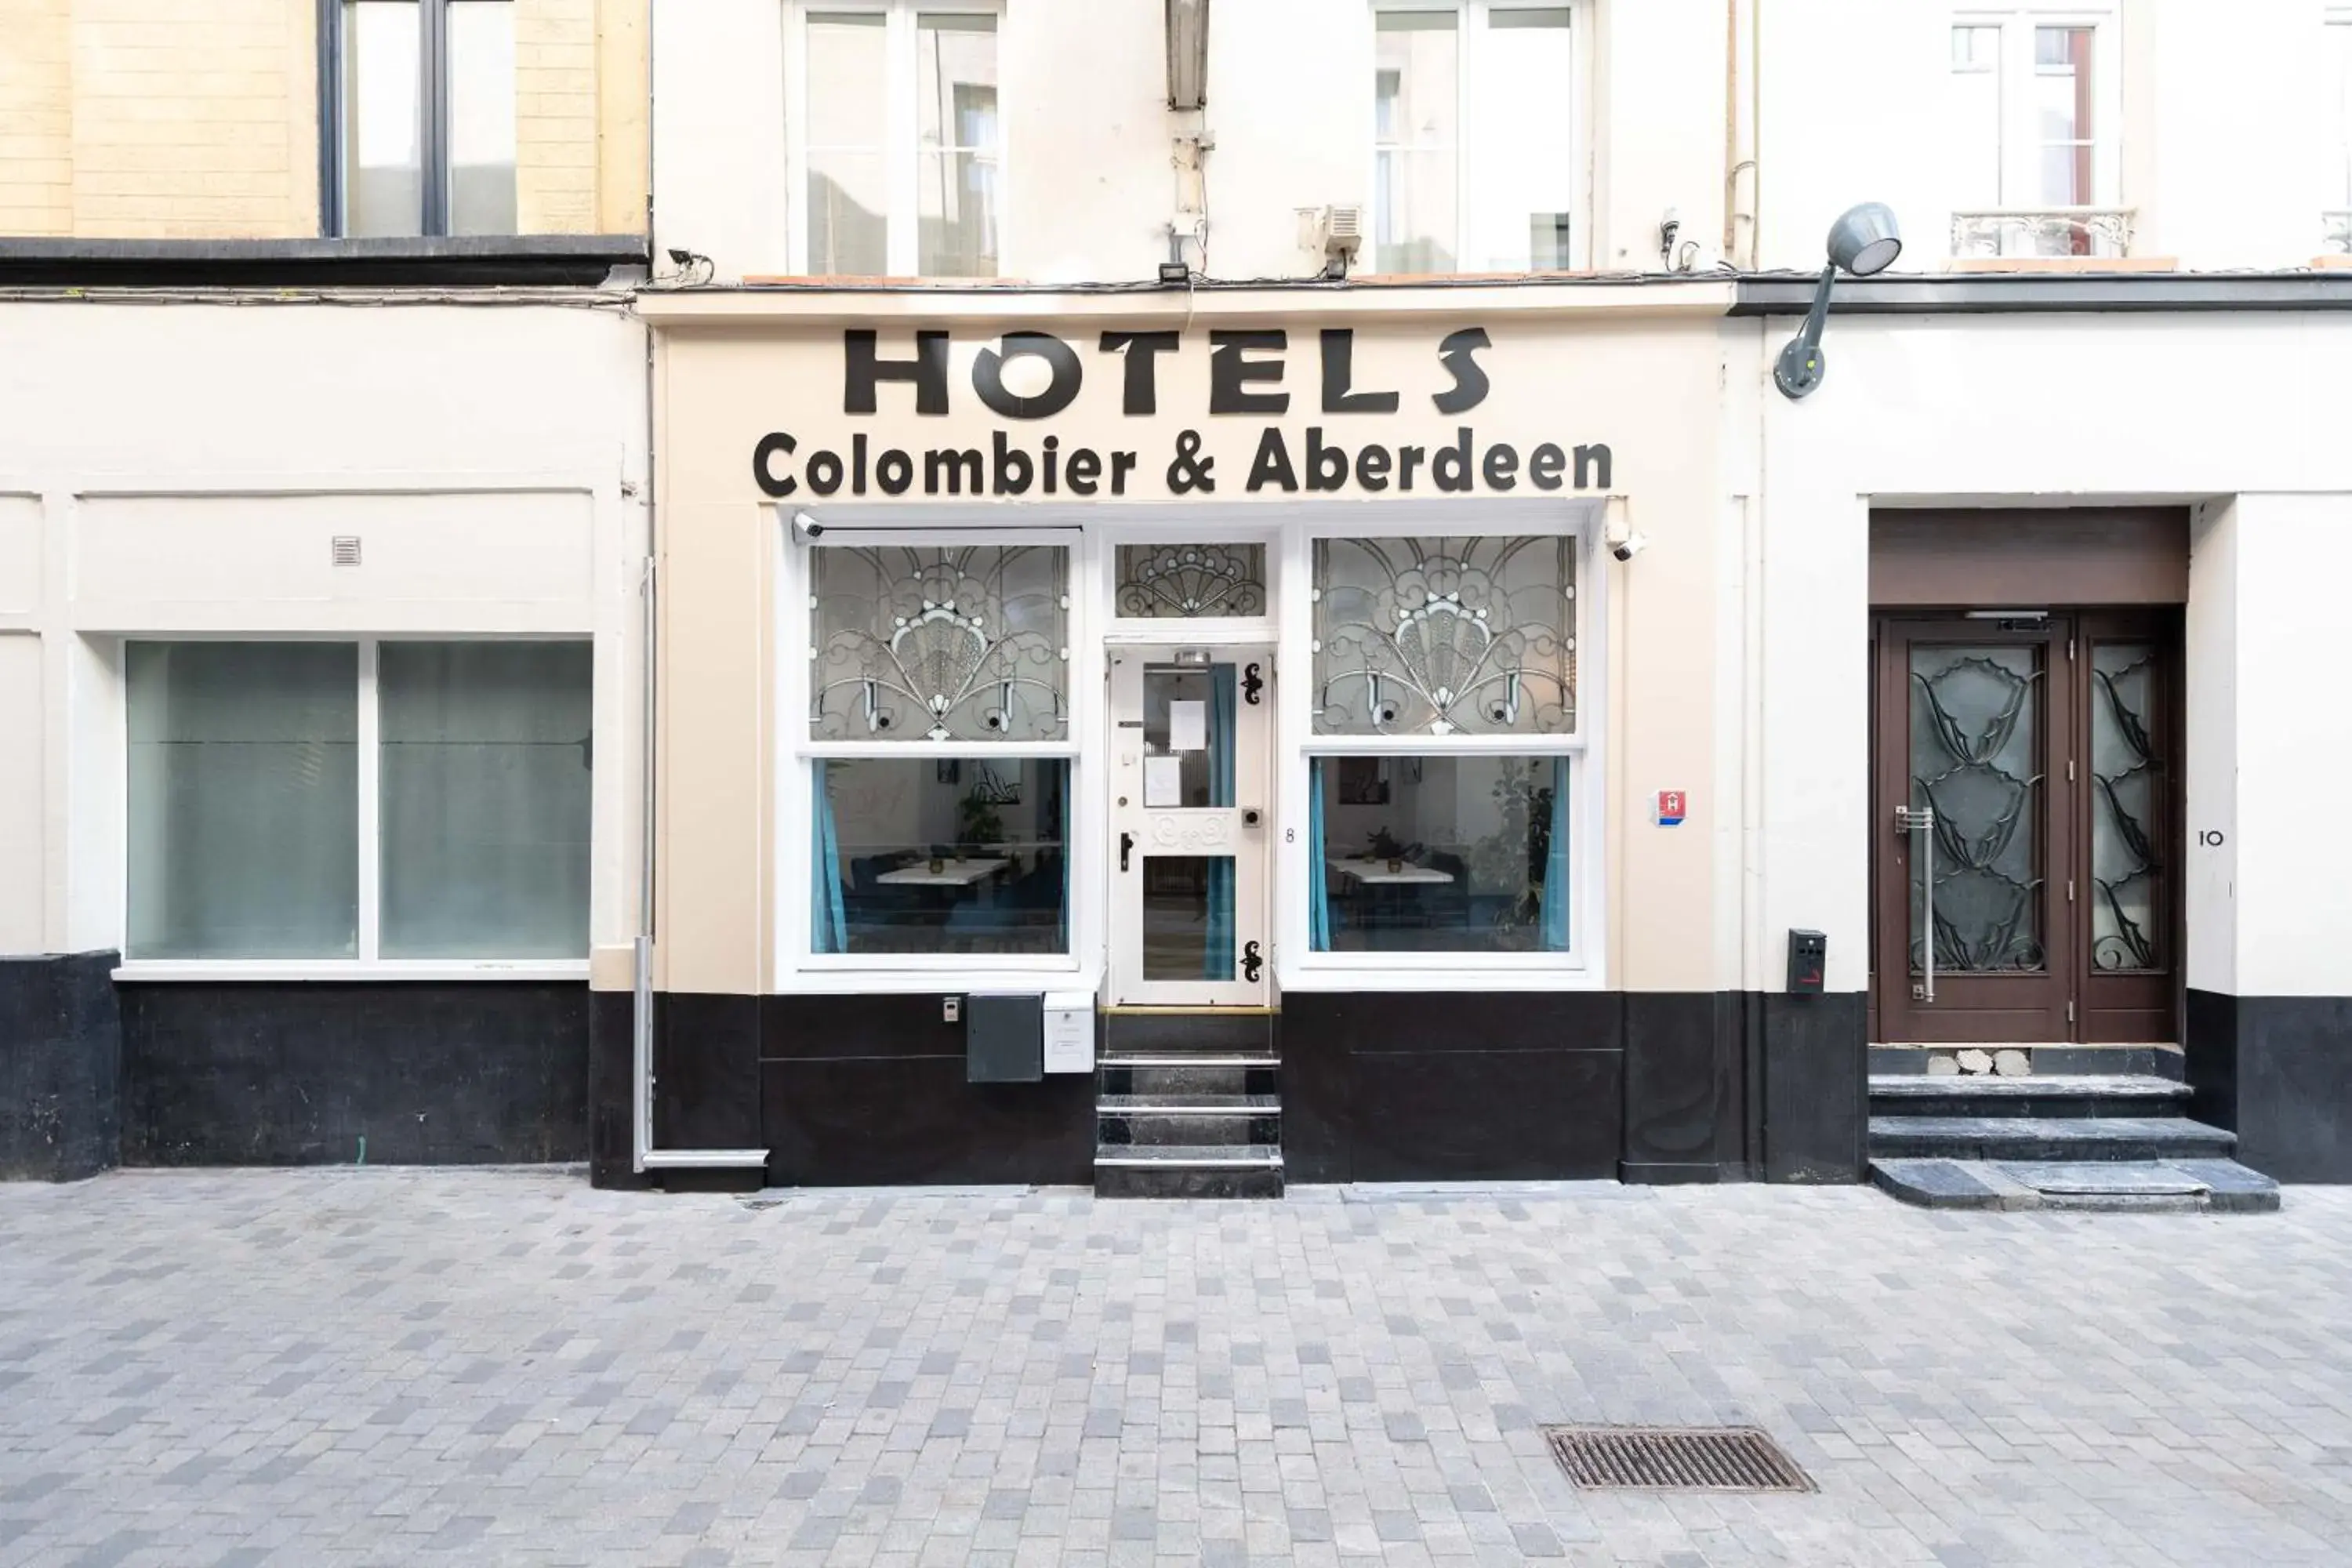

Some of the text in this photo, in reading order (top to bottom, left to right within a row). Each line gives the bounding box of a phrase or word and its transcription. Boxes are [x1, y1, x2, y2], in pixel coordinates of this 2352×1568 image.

[843, 325, 1493, 419] HOTELS
[753, 426, 1612, 498] Colombier & Aberdeen
[1285, 827, 1294, 843] 8
[2198, 830, 2224, 847] 10
